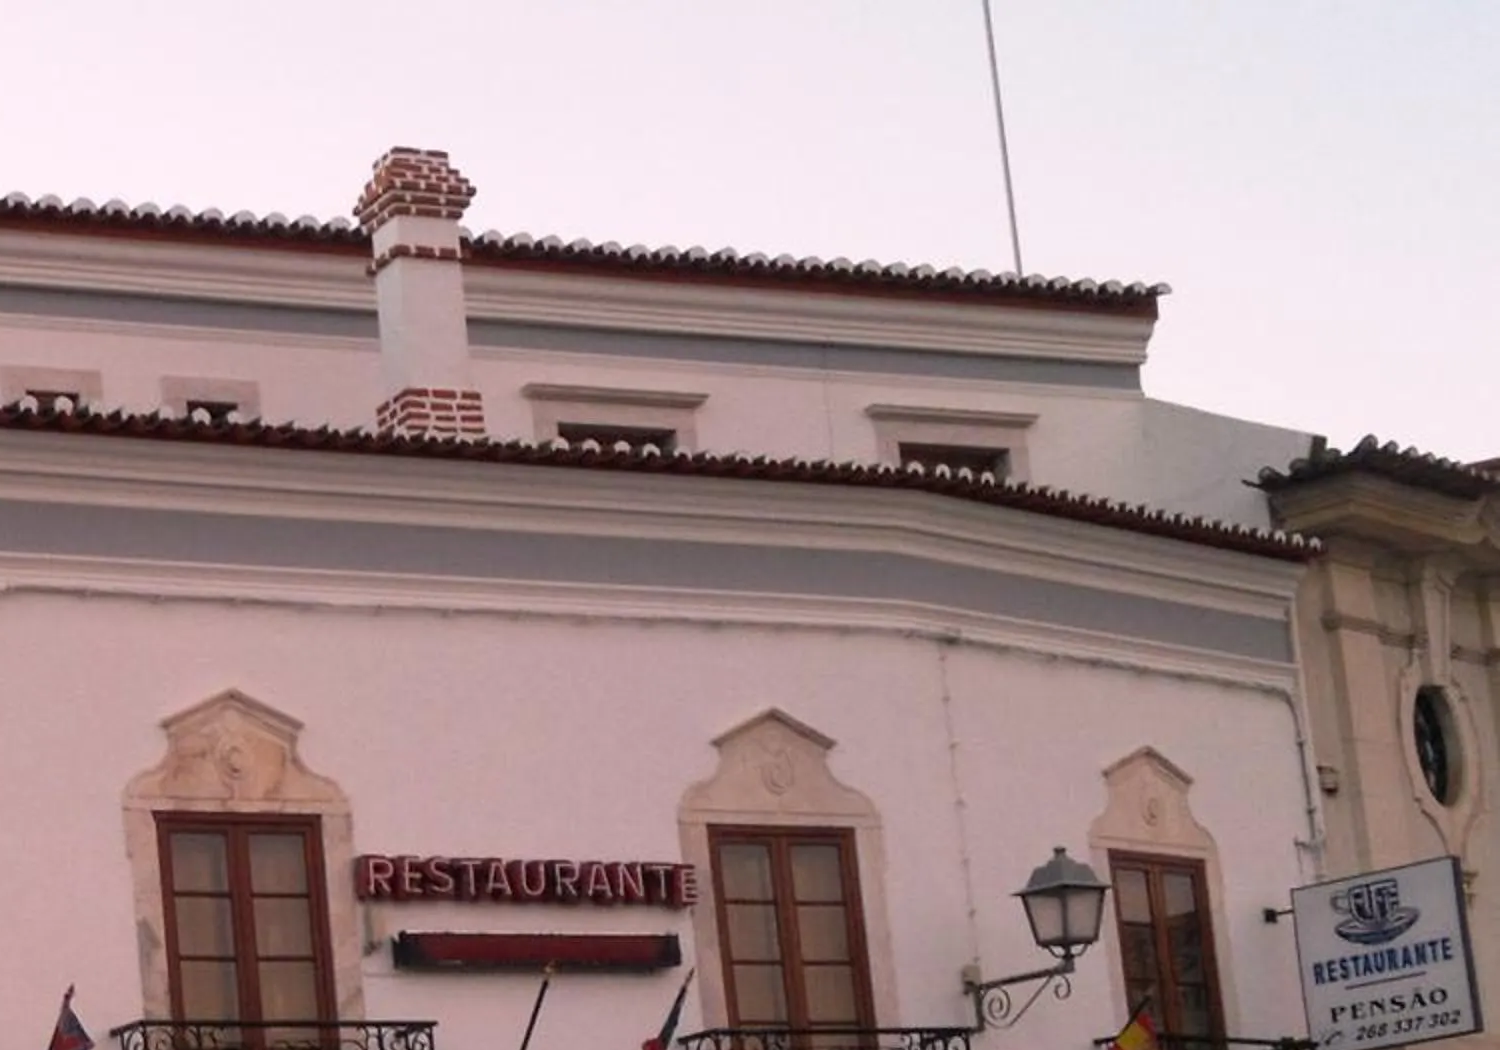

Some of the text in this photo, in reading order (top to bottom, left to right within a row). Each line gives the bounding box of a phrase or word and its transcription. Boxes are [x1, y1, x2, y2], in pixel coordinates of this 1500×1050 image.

[360, 855, 698, 905] RESTAURANTE
[1313, 937, 1453, 985] RESTAURANTE
[1330, 987, 1448, 1023] PENSÃO
